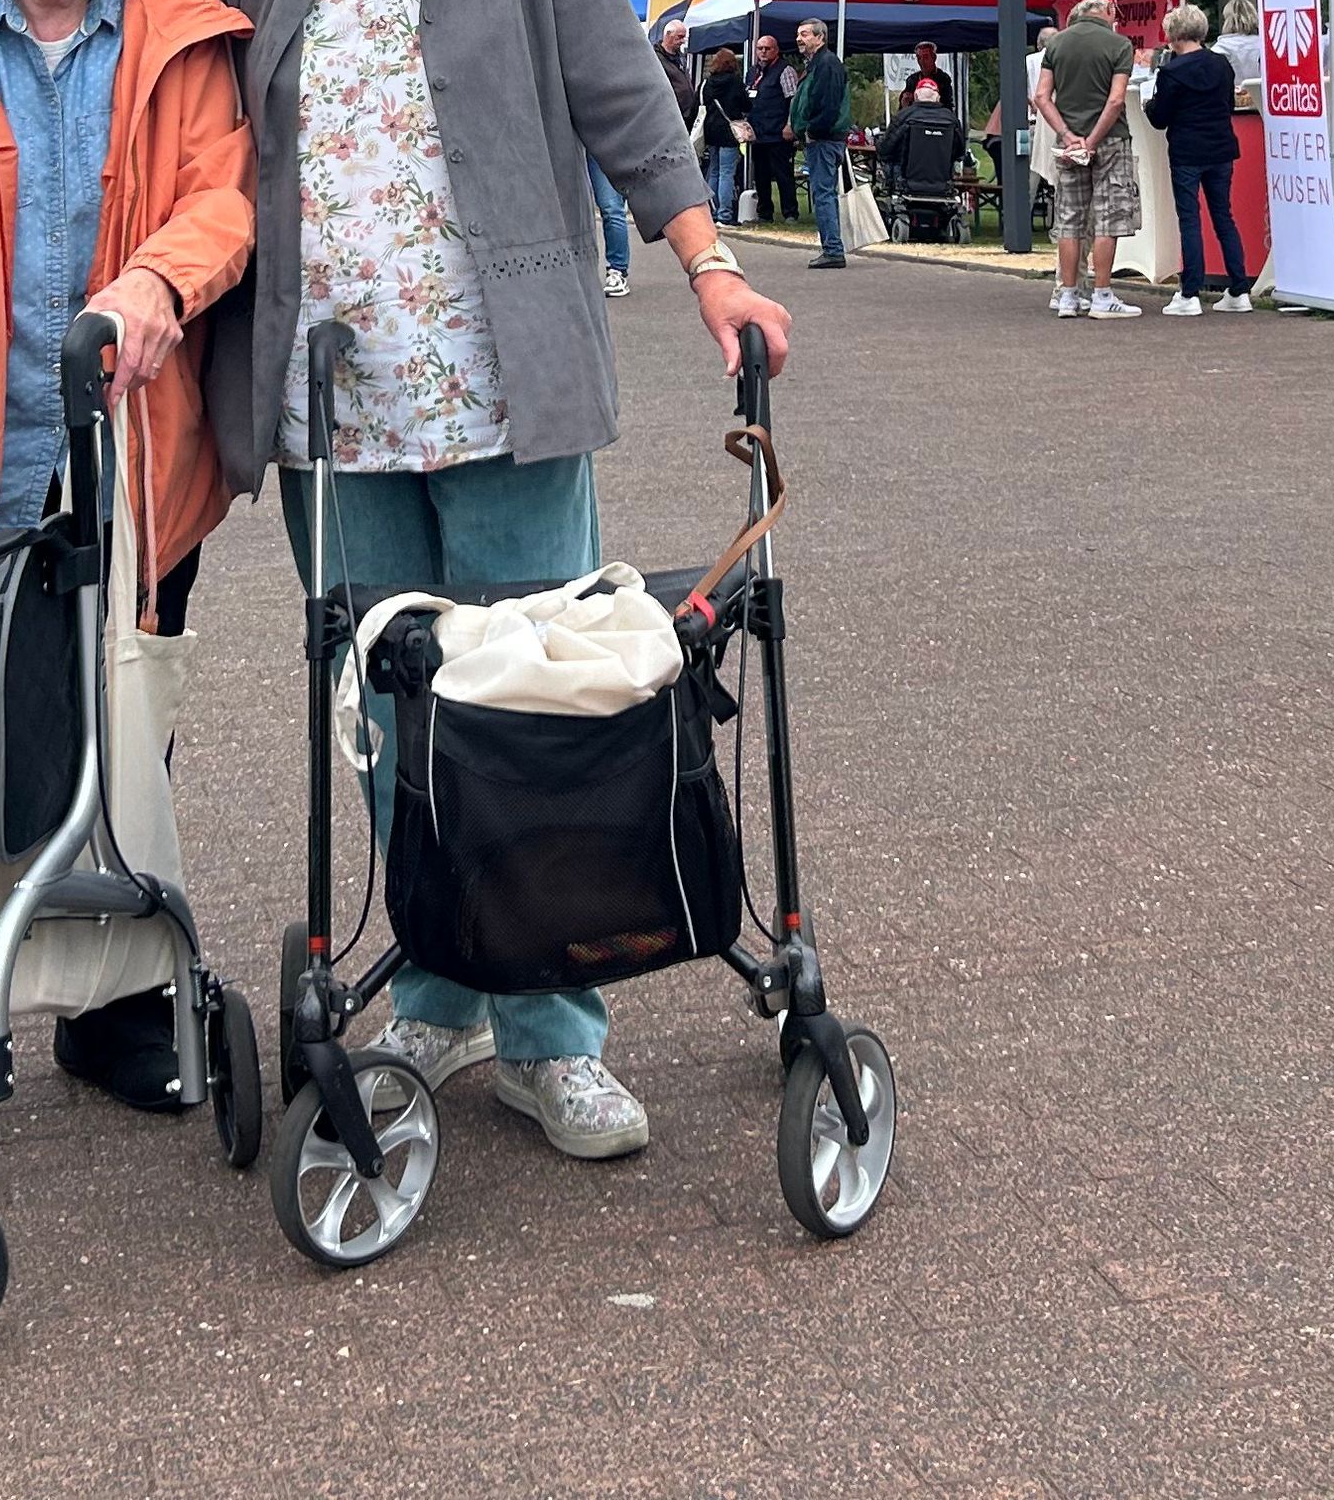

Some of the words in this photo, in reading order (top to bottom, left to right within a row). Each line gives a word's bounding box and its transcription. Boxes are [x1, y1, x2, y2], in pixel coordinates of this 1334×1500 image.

[1270, 74, 1318, 113] caritas
[1269, 131, 1327, 161] LEVER
[1271, 173, 1330, 206] KUSEN
